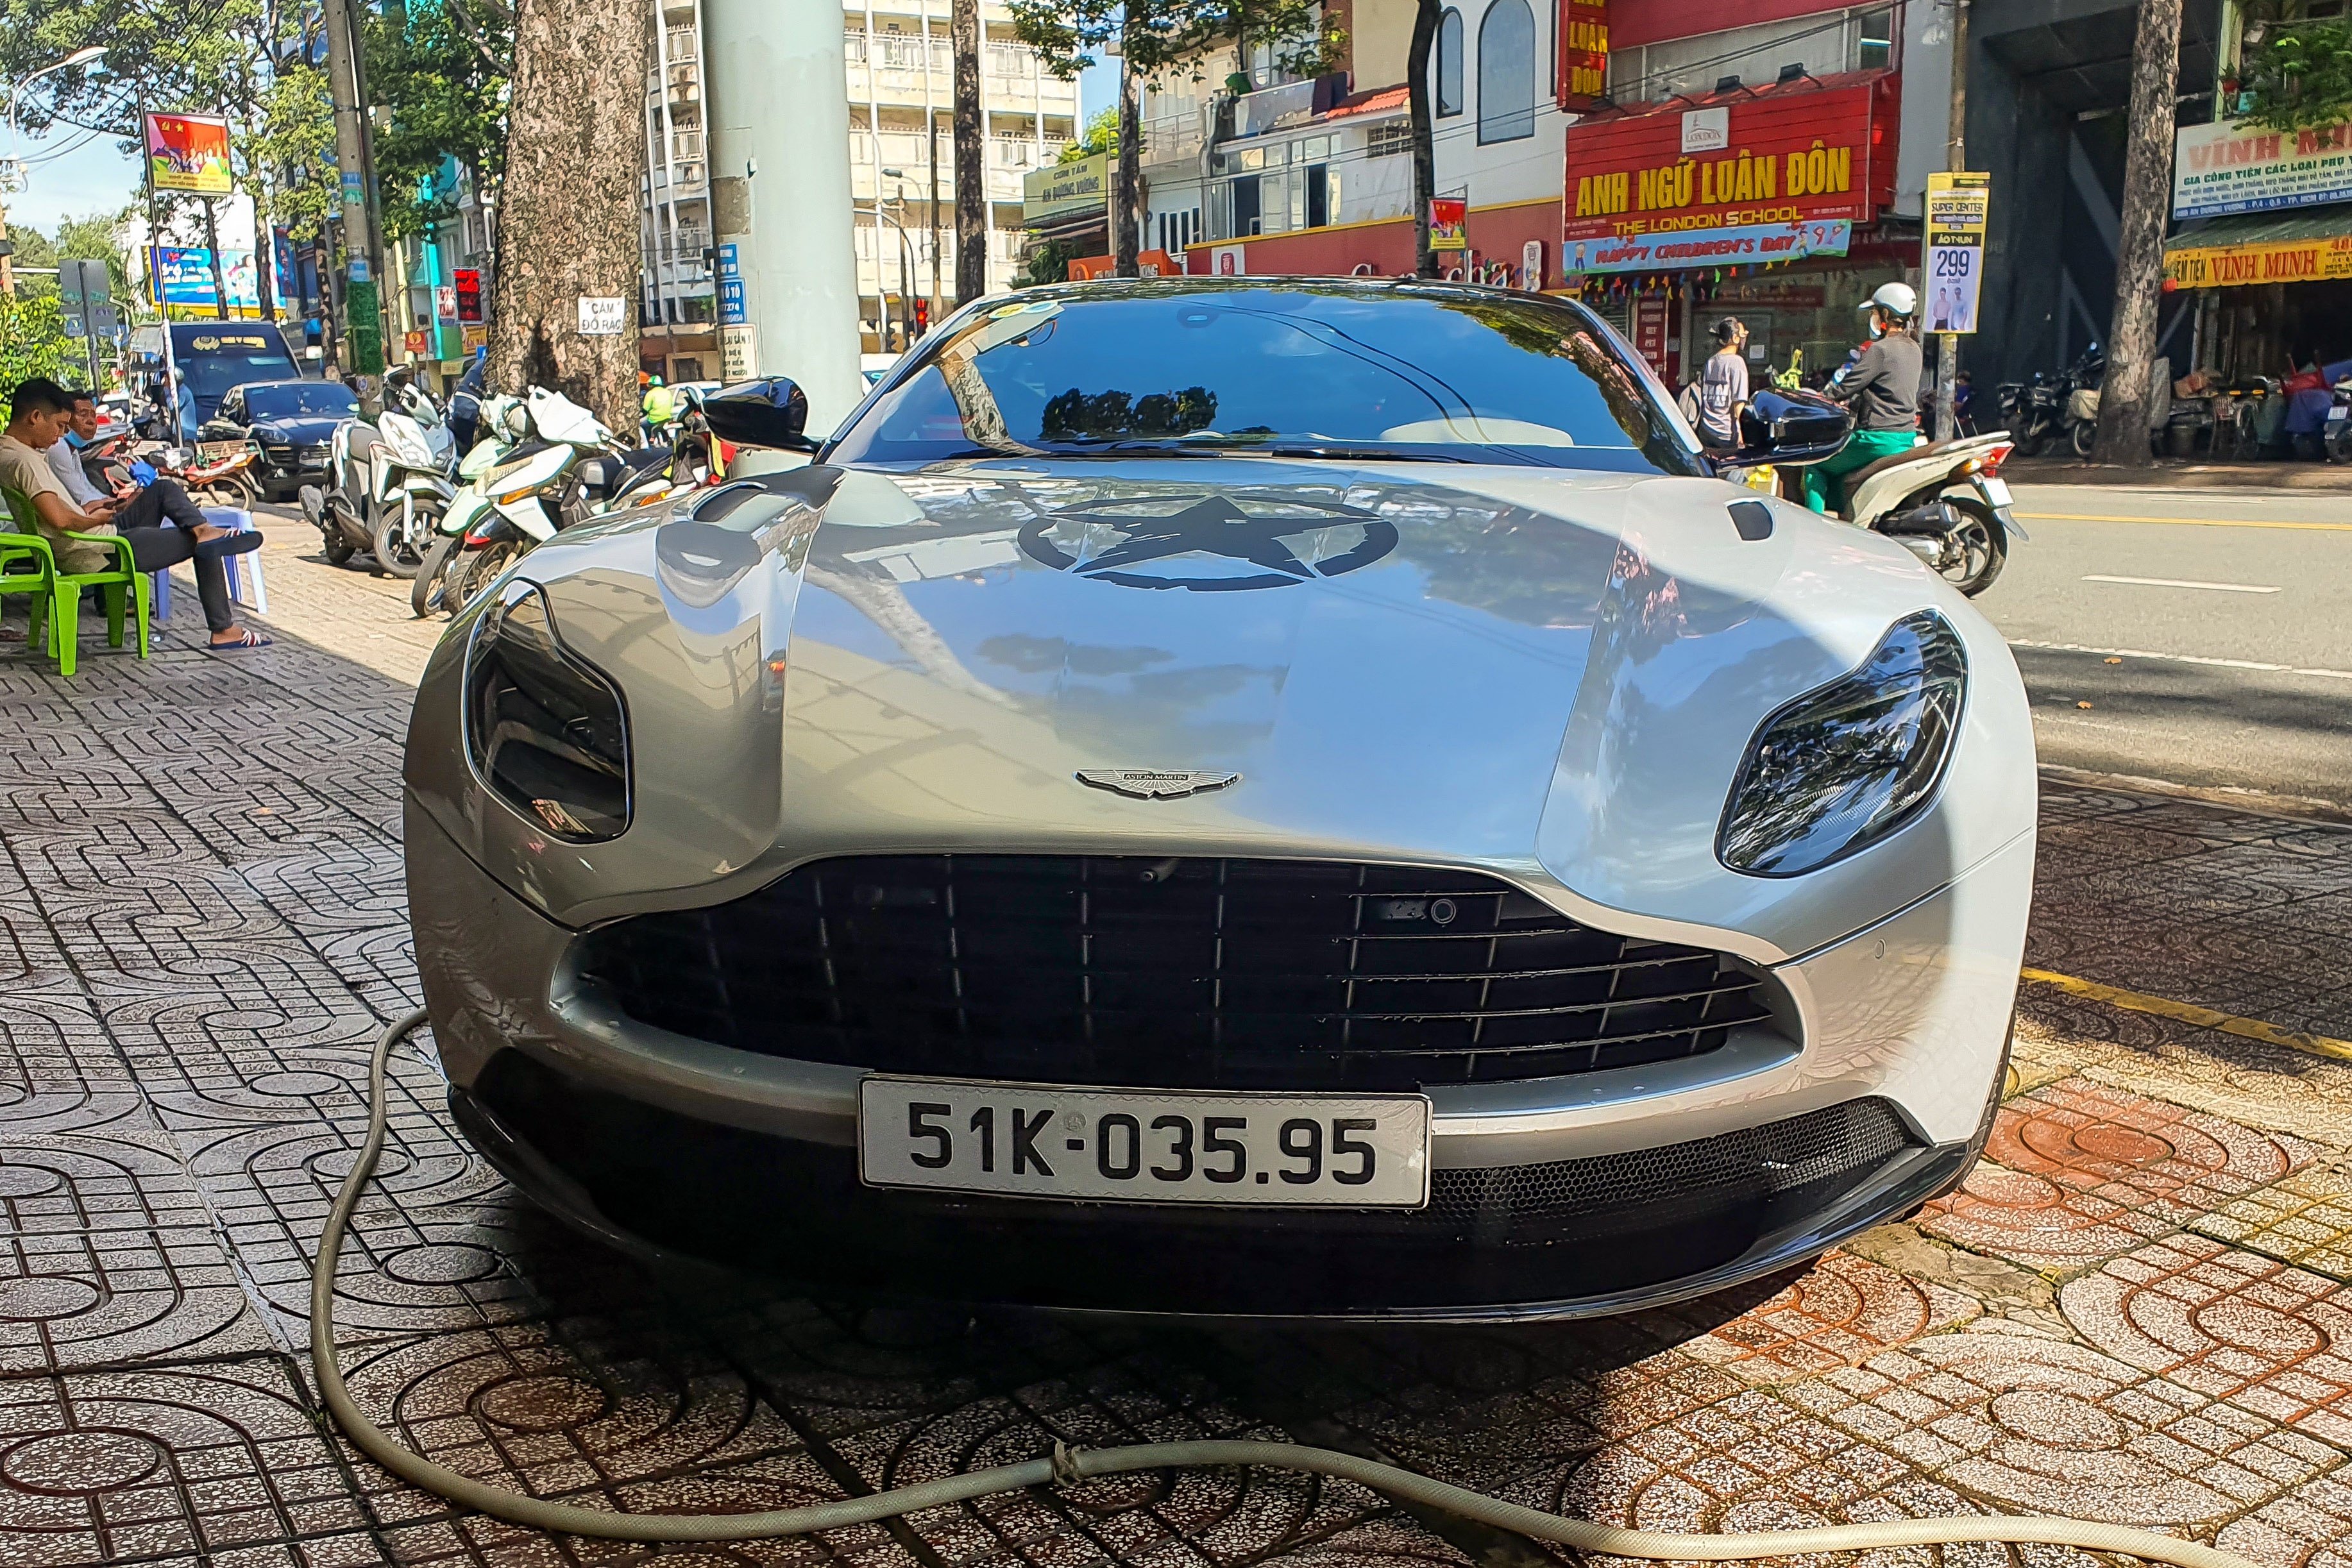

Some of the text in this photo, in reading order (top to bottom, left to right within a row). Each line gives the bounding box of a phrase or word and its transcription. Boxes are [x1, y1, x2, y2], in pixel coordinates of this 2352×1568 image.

[1575, 139, 1850, 217] ANH NGỮ LUÂN ĐÔN
[1612, 219, 1646, 235] THE
[1650, 212, 1722, 232] LONDON
[1726, 206, 1804, 226] SCHOOL
[1595, 235, 1797, 264] HAPPY CHILDREN'S DAY
[1936, 249, 1970, 277] 299
[2211, 249, 2258, 282] VĨNH
[2263, 249, 2318, 278] MINH
[909, 1102, 1378, 1185] 51K-035.95
